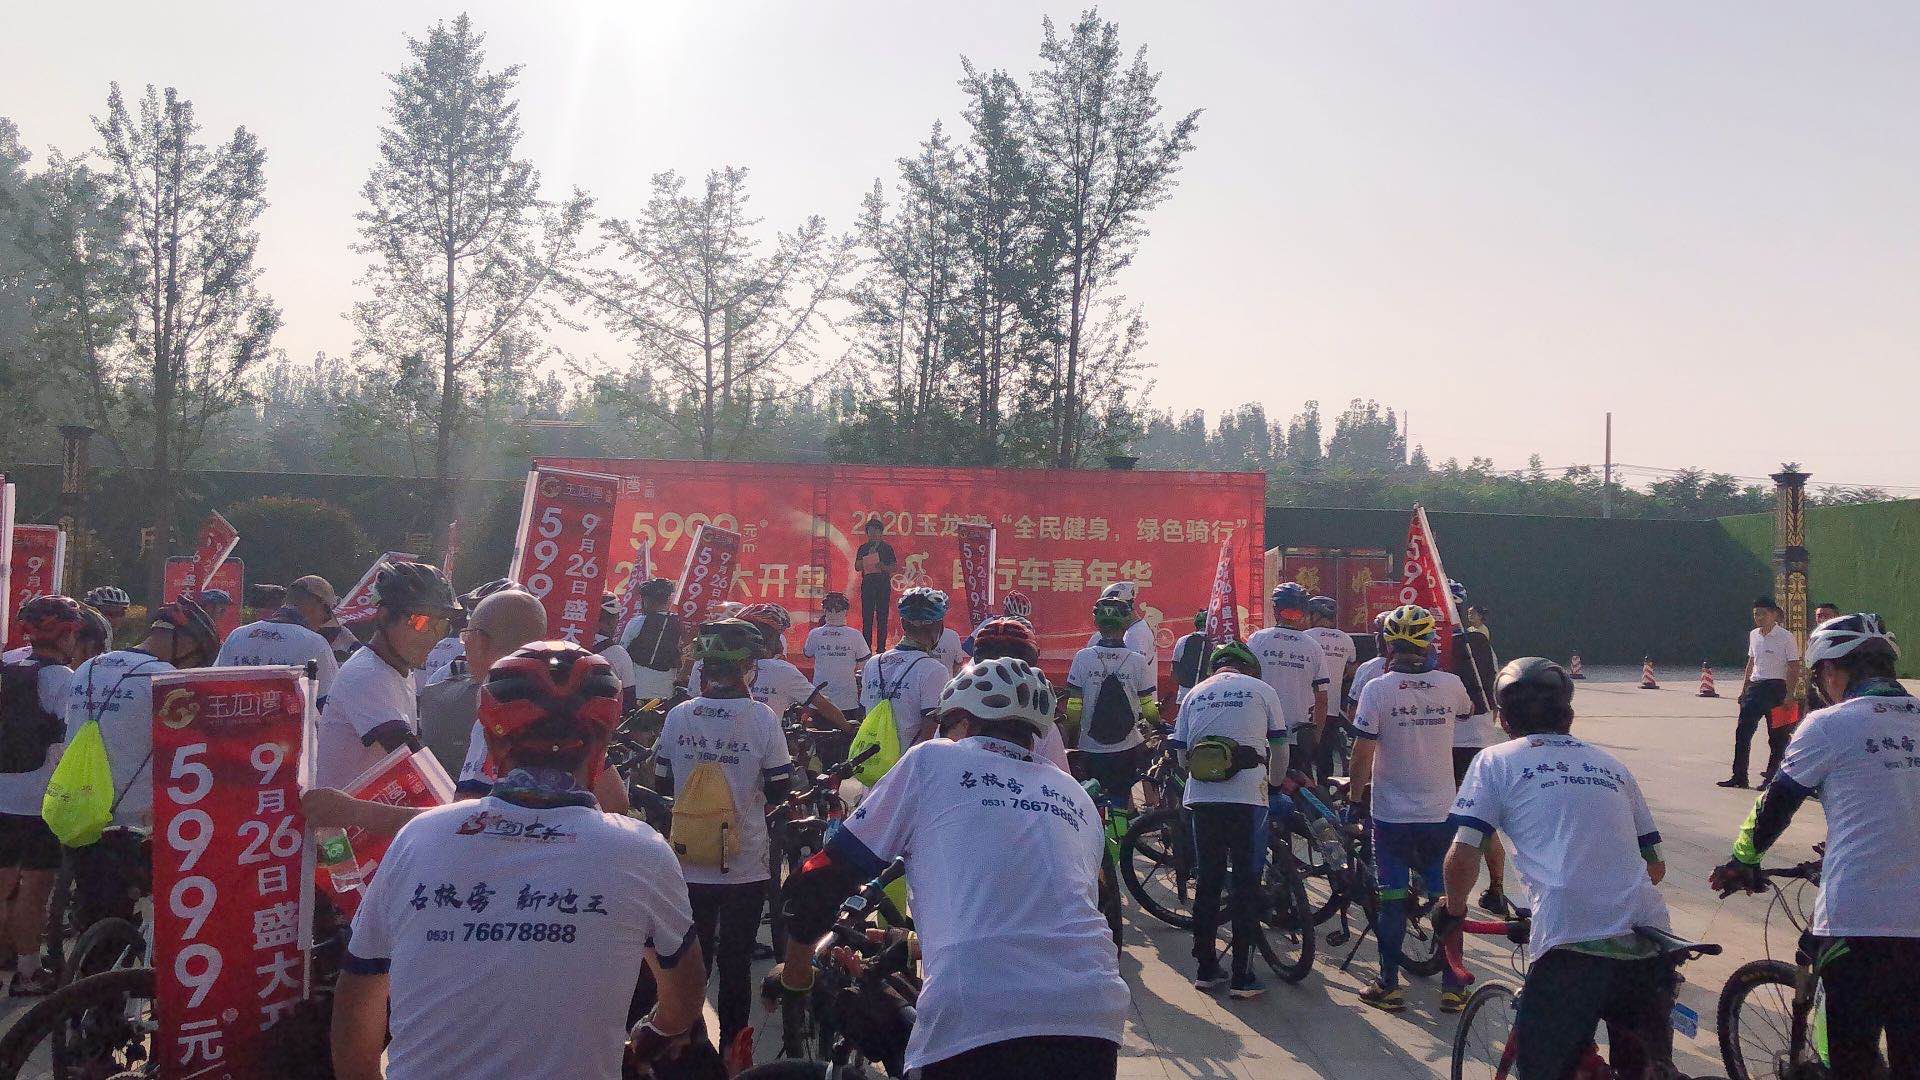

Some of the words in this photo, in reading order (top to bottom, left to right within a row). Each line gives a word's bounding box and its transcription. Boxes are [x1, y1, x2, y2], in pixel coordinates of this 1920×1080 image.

[981, 798, 1006, 808] 0531
[1010, 797, 1080, 832] 76678888
[426, 930, 454, 942] 0531
[462, 922, 576, 944] 76678888
